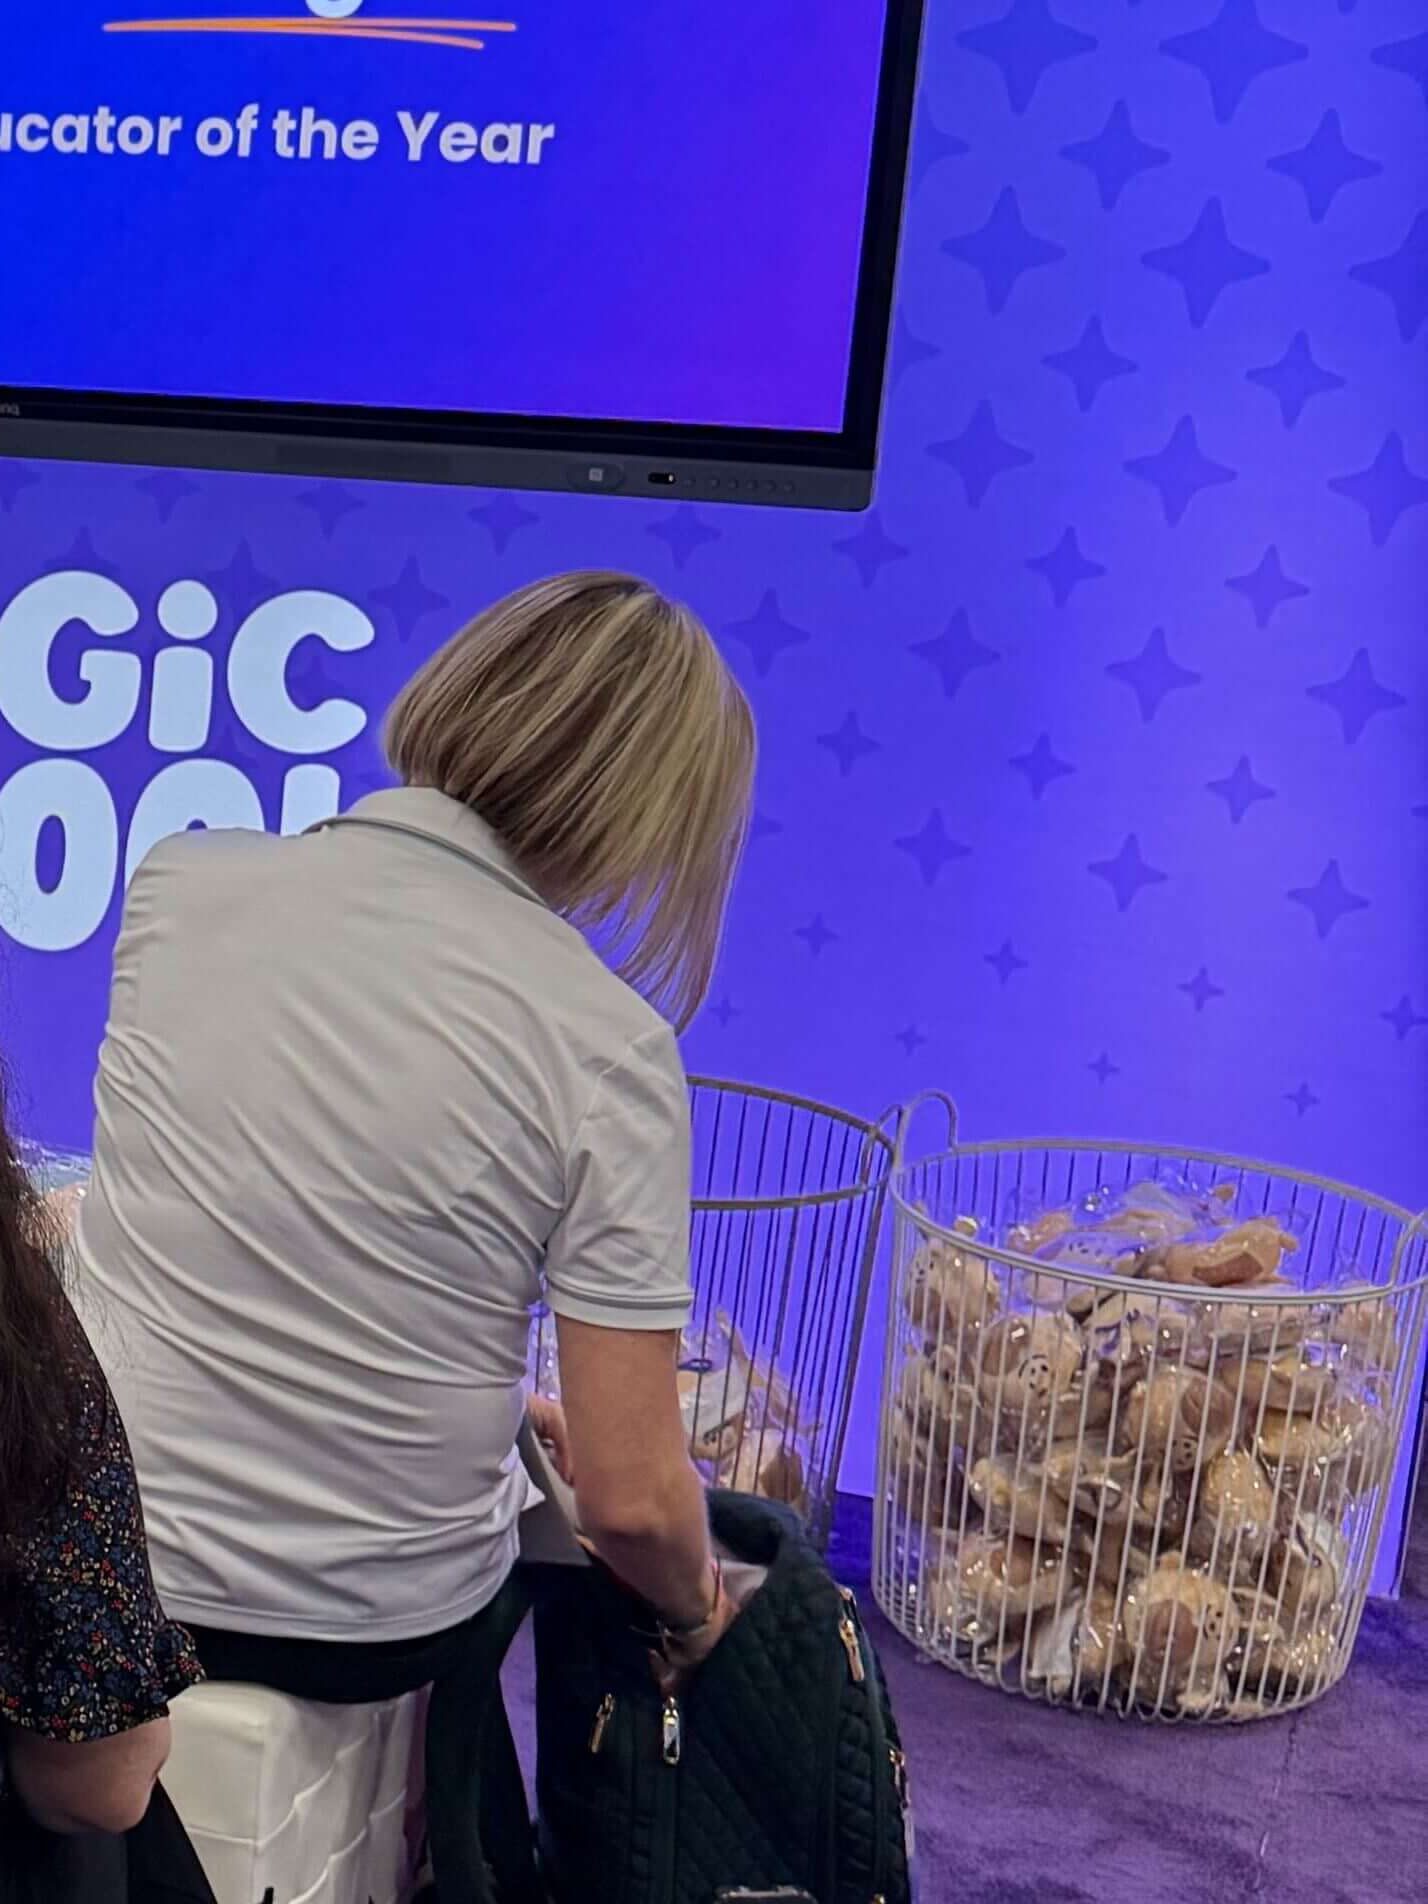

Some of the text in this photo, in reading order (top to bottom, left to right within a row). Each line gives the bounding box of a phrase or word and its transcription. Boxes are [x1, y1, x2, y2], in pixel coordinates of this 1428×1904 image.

[195, 102, 260, 158] of
[272, 106, 380, 161] the
[396, 110, 556, 165] Year
